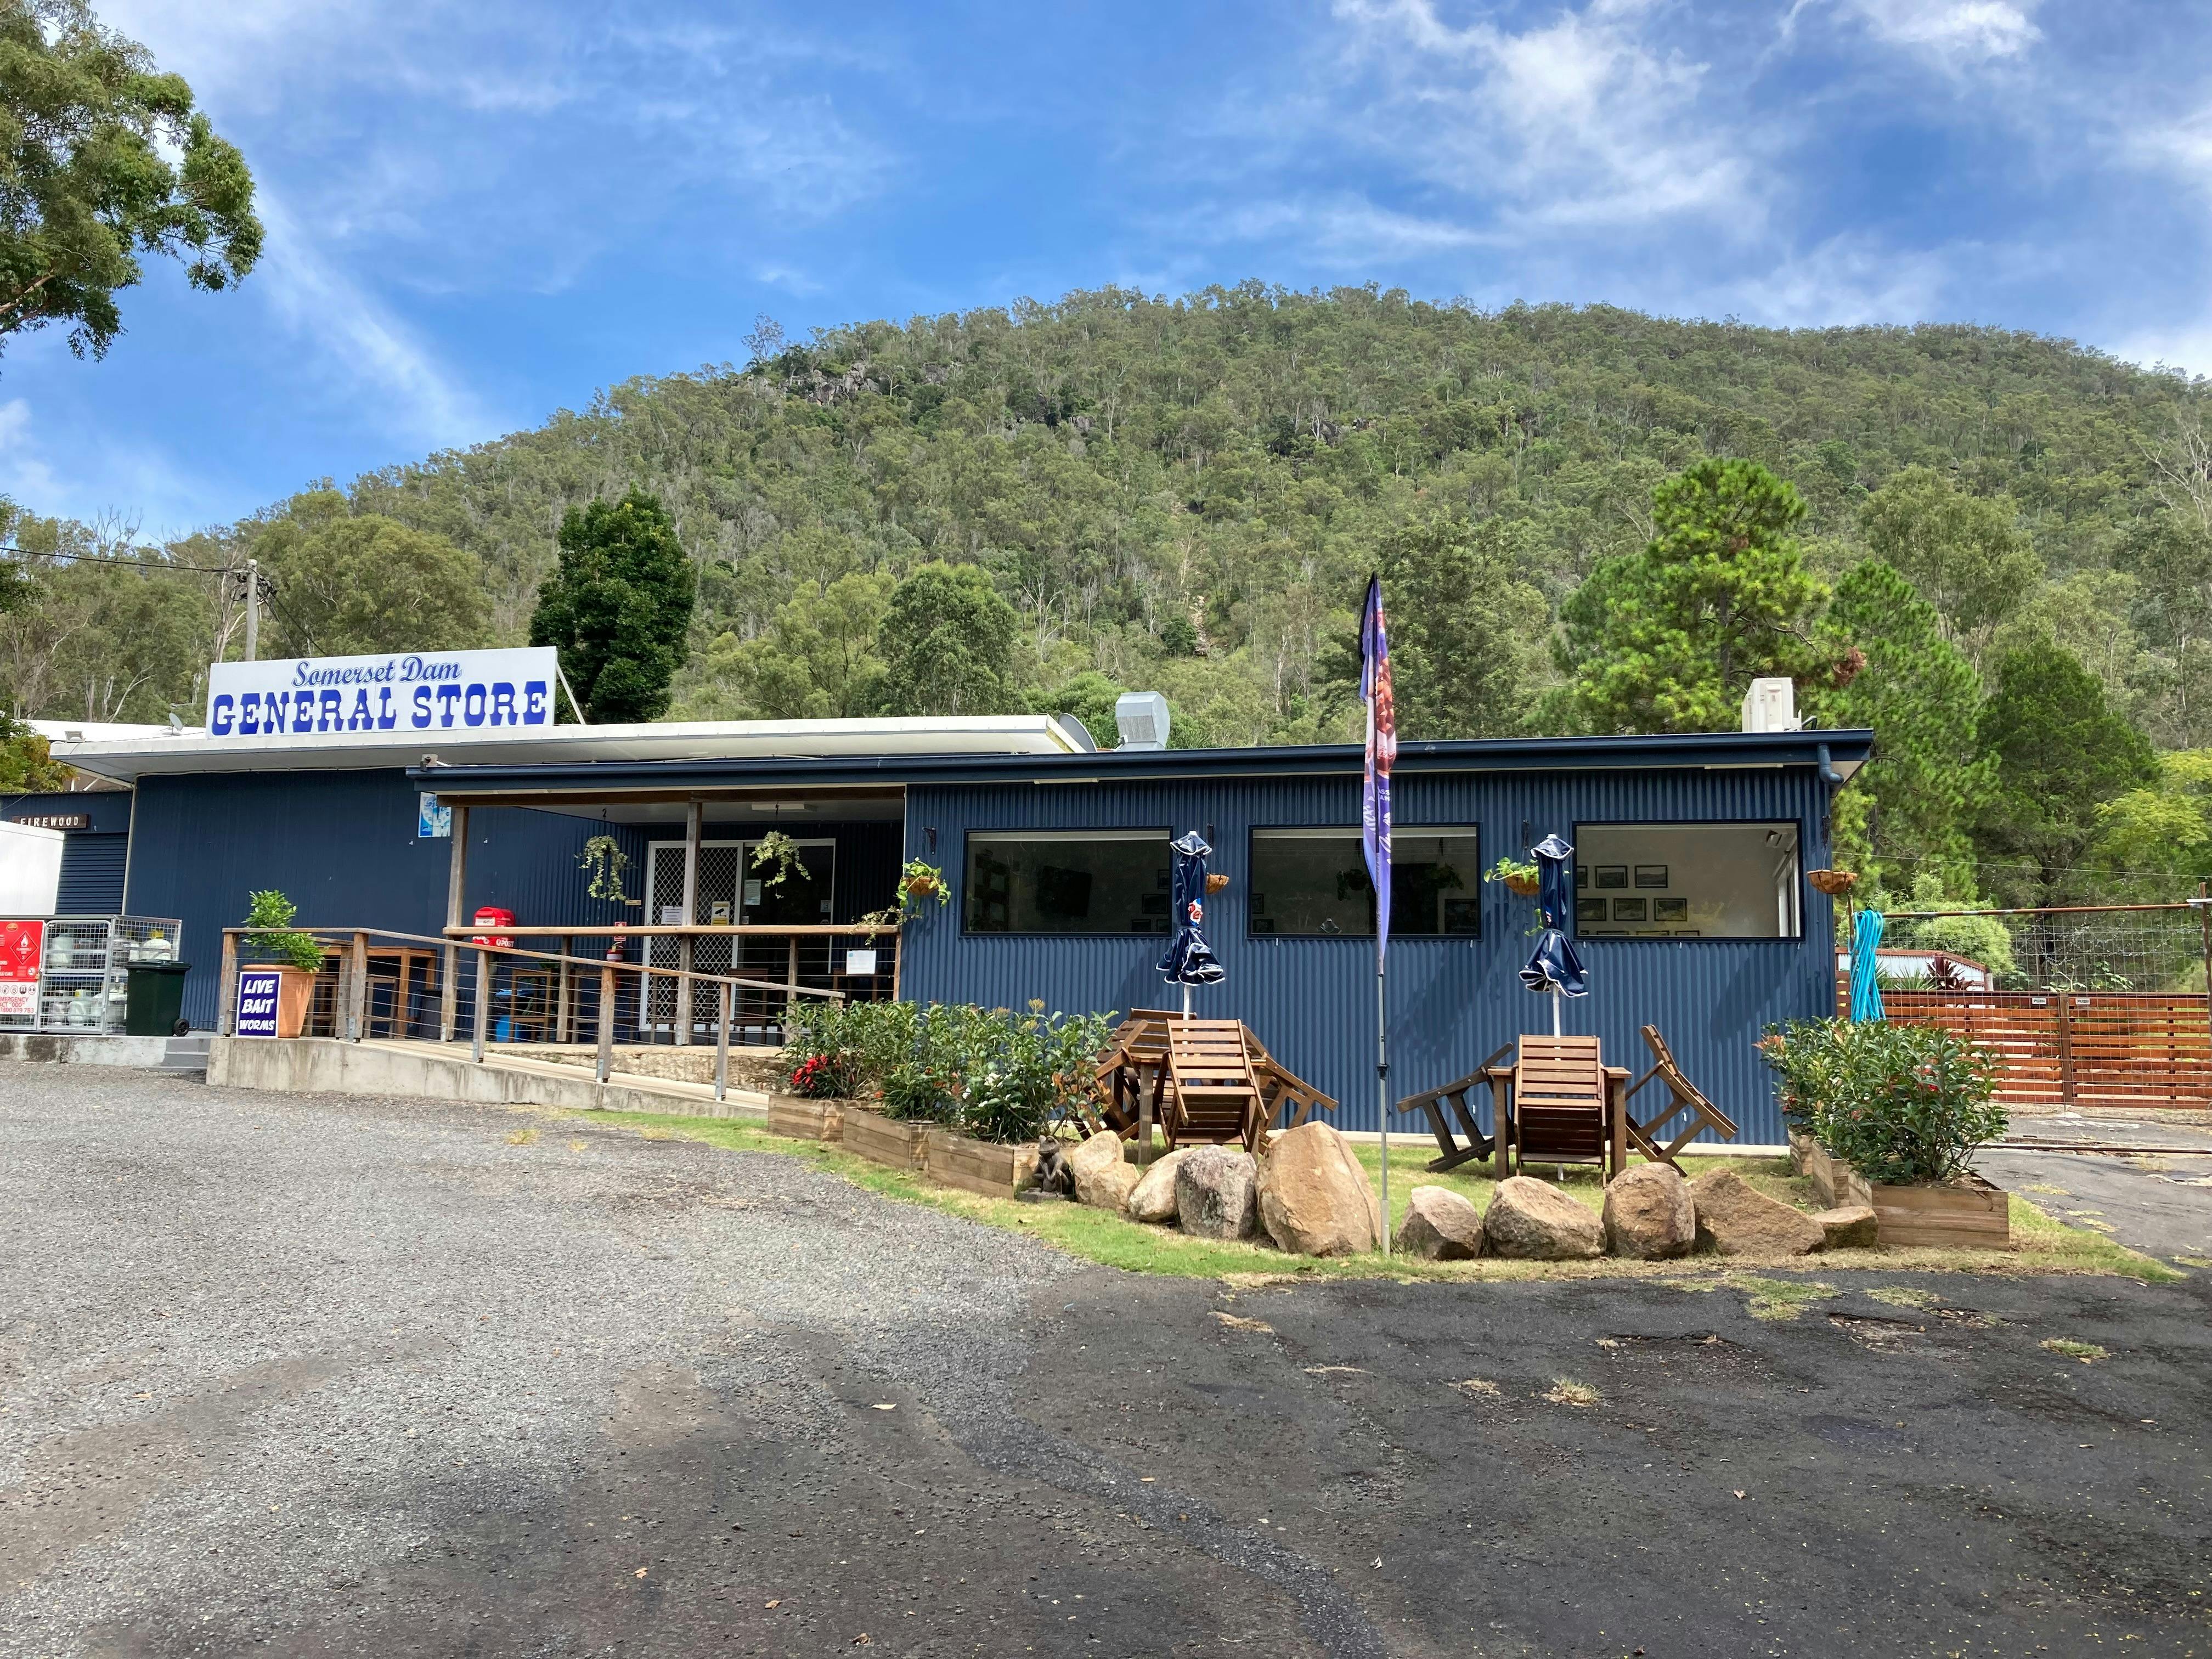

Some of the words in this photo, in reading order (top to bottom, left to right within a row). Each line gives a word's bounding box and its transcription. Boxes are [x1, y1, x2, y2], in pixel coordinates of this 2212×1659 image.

[291, 659, 397, 687] Somerset
[399, 654, 462, 683] Dam
[211, 686, 397, 736] GENERAL
[411, 680, 548, 729] STORE
[20, 816, 79, 827] FIREWOOD
[243, 980, 275, 994] LIVE
[241, 998, 274, 1014] BAIT
[239, 1019, 275, 1030] WORMS
